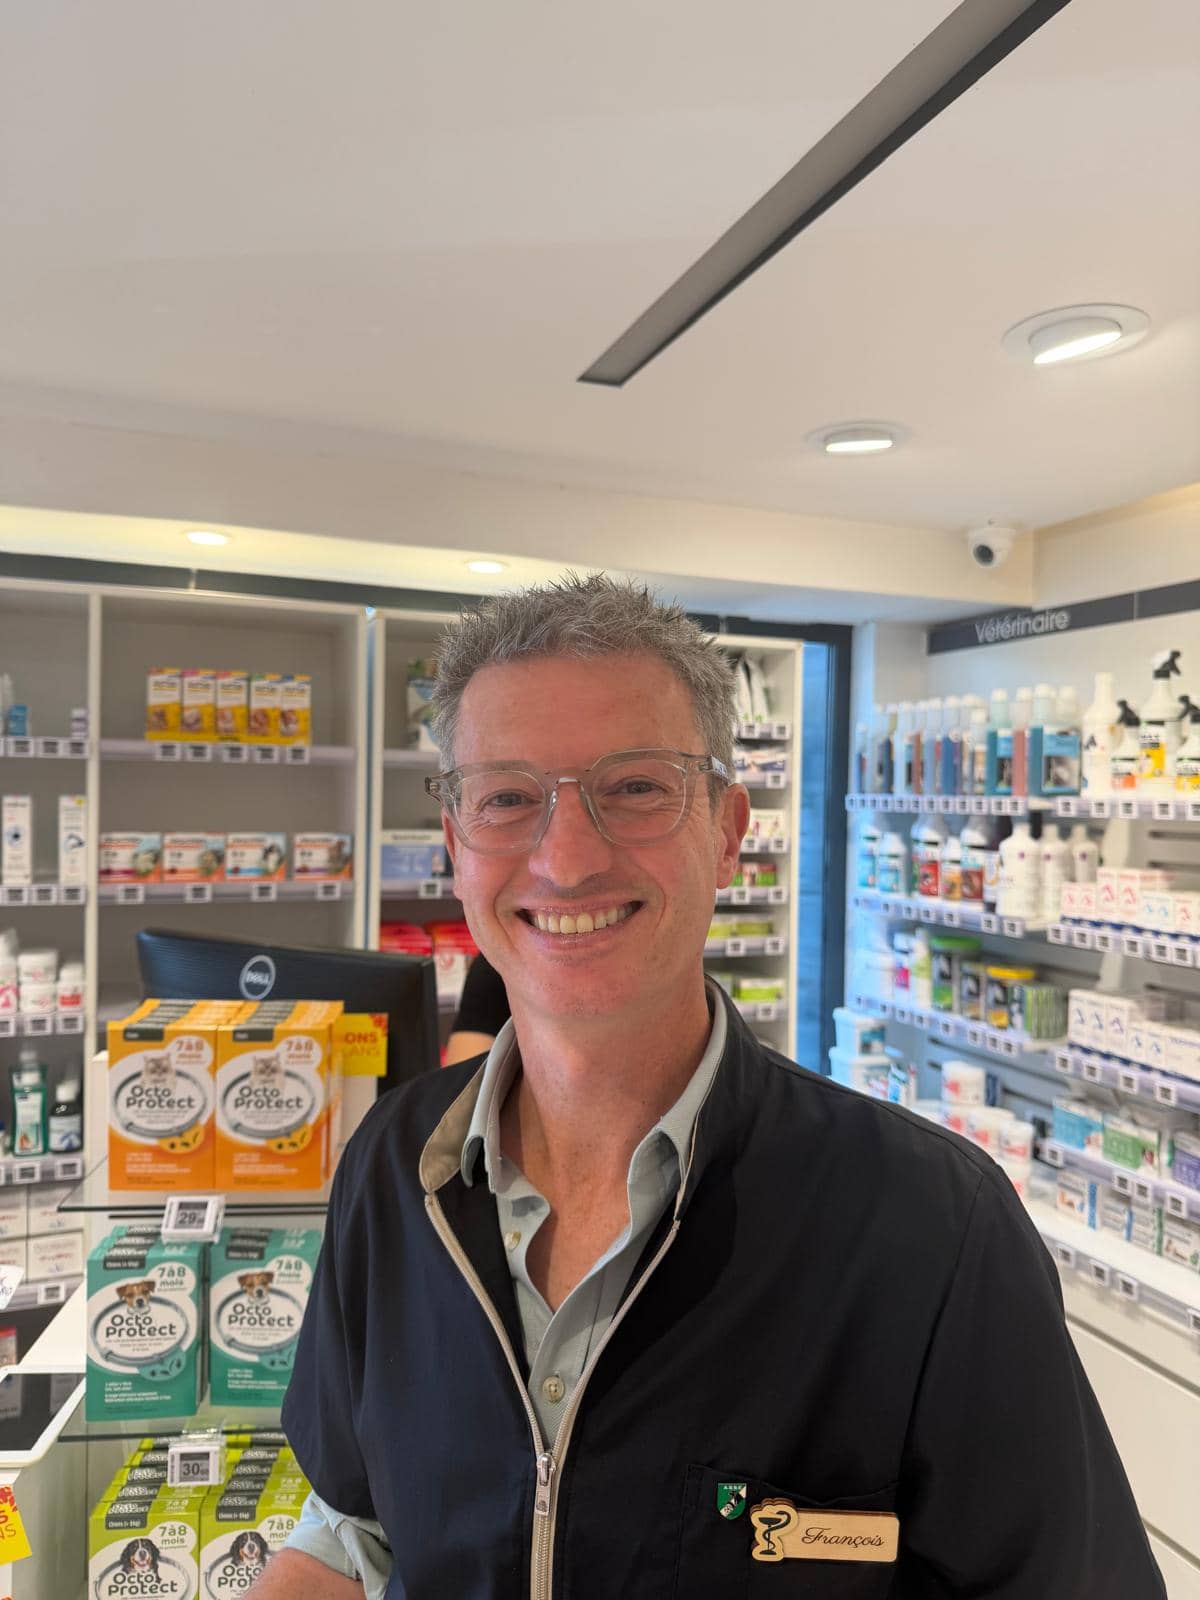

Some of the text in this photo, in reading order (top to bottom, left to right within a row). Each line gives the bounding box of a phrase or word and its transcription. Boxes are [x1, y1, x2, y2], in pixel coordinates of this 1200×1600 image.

[975, 609, 1071, 643] Vétérinaire
[344, 1031, 378, 1044] ONS
[131, 1084, 172, 1098] Octo
[239, 1084, 281, 1098] Octo
[126, 1095, 195, 1109] Protect
[234, 1095, 303, 1109] Protect
[232, 1302, 272, 1316] Octo
[111, 1314, 153, 1327] Octo
[228, 1314, 294, 1327] Protect
[106, 1323, 176, 1338] Protect
[161, 1537, 185, 1545] mois
[801, 1526, 885, 1548] François
[223, 1564, 262, 1577] Octo
[113, 1572, 155, 1584] Octo
[108, 1580, 178, 1596] Protect
